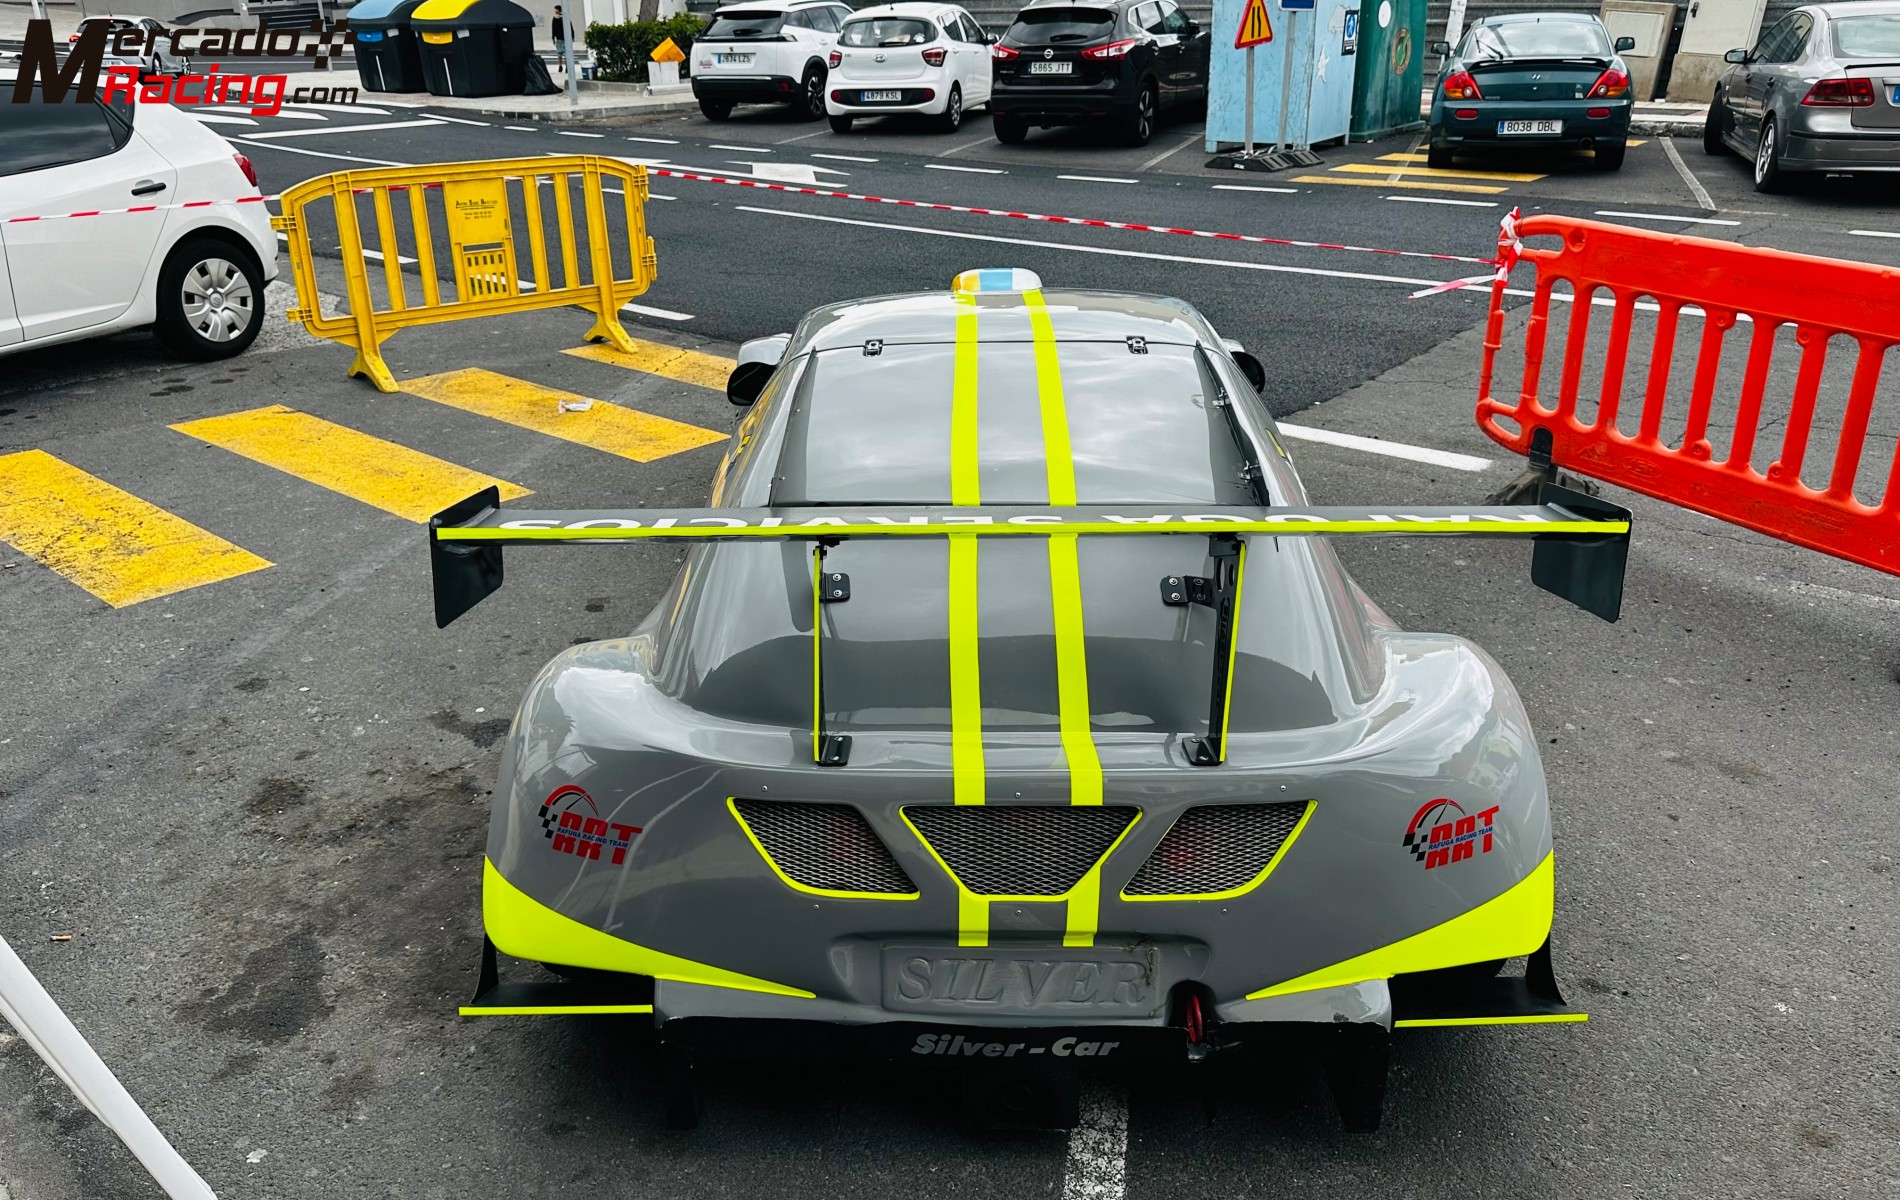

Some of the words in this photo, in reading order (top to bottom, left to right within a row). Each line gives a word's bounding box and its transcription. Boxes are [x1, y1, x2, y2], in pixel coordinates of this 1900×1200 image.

[1033, 63, 1053, 72] 5865
[1055, 63, 1071, 72] JTT
[866, 91, 884, 100] 4879
[885, 91, 900, 99] KSL
[1506, 122, 1532, 132] 8038
[1537, 122, 1556, 132] DBL
[556, 827, 581, 839] RAFUGA
[582, 833, 608, 844] RACING
[609, 839, 629, 848] TEAM
[1428, 840, 1454, 850] RAFUGA
[1455, 831, 1477, 843] RACING
[1478, 826, 1494, 836] TEAM
[895, 957, 1147, 1006] SILVER
